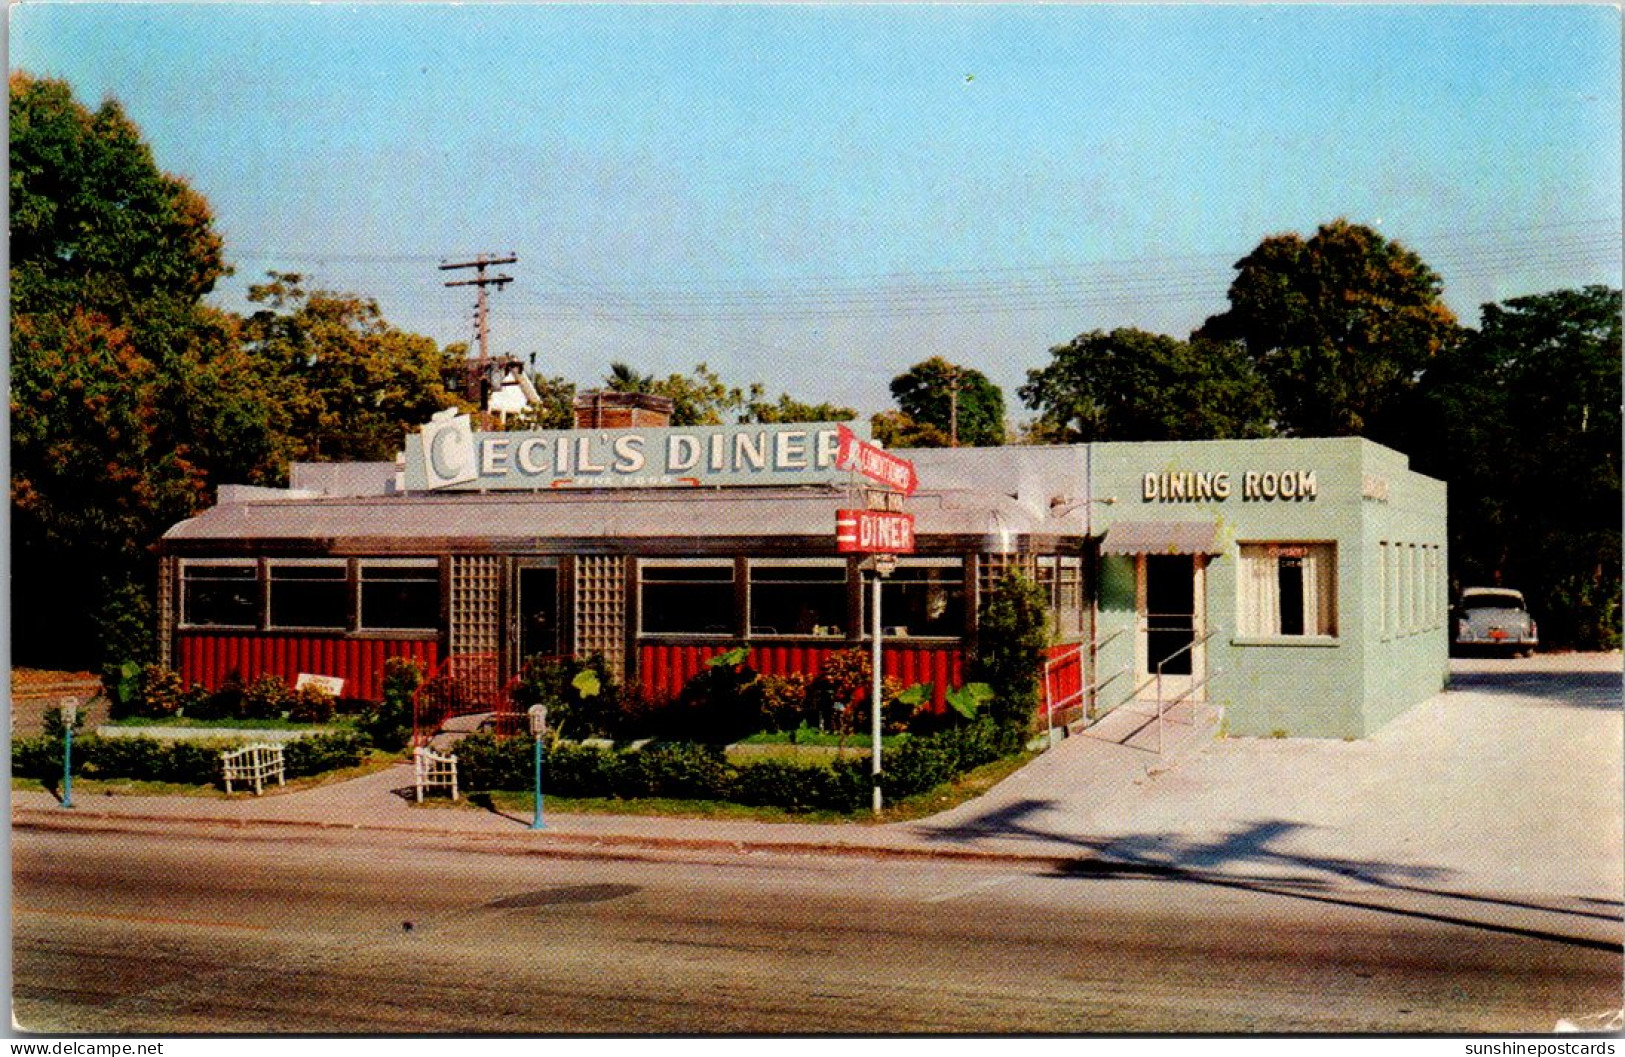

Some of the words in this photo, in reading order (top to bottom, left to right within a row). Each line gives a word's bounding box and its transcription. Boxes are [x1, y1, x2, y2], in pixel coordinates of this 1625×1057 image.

[431, 425, 646, 480] CECIL'S
[1143, 470, 1231, 502] DINING
[1242, 470, 1318, 502] ROOM
[860, 514, 909, 549] DINER
